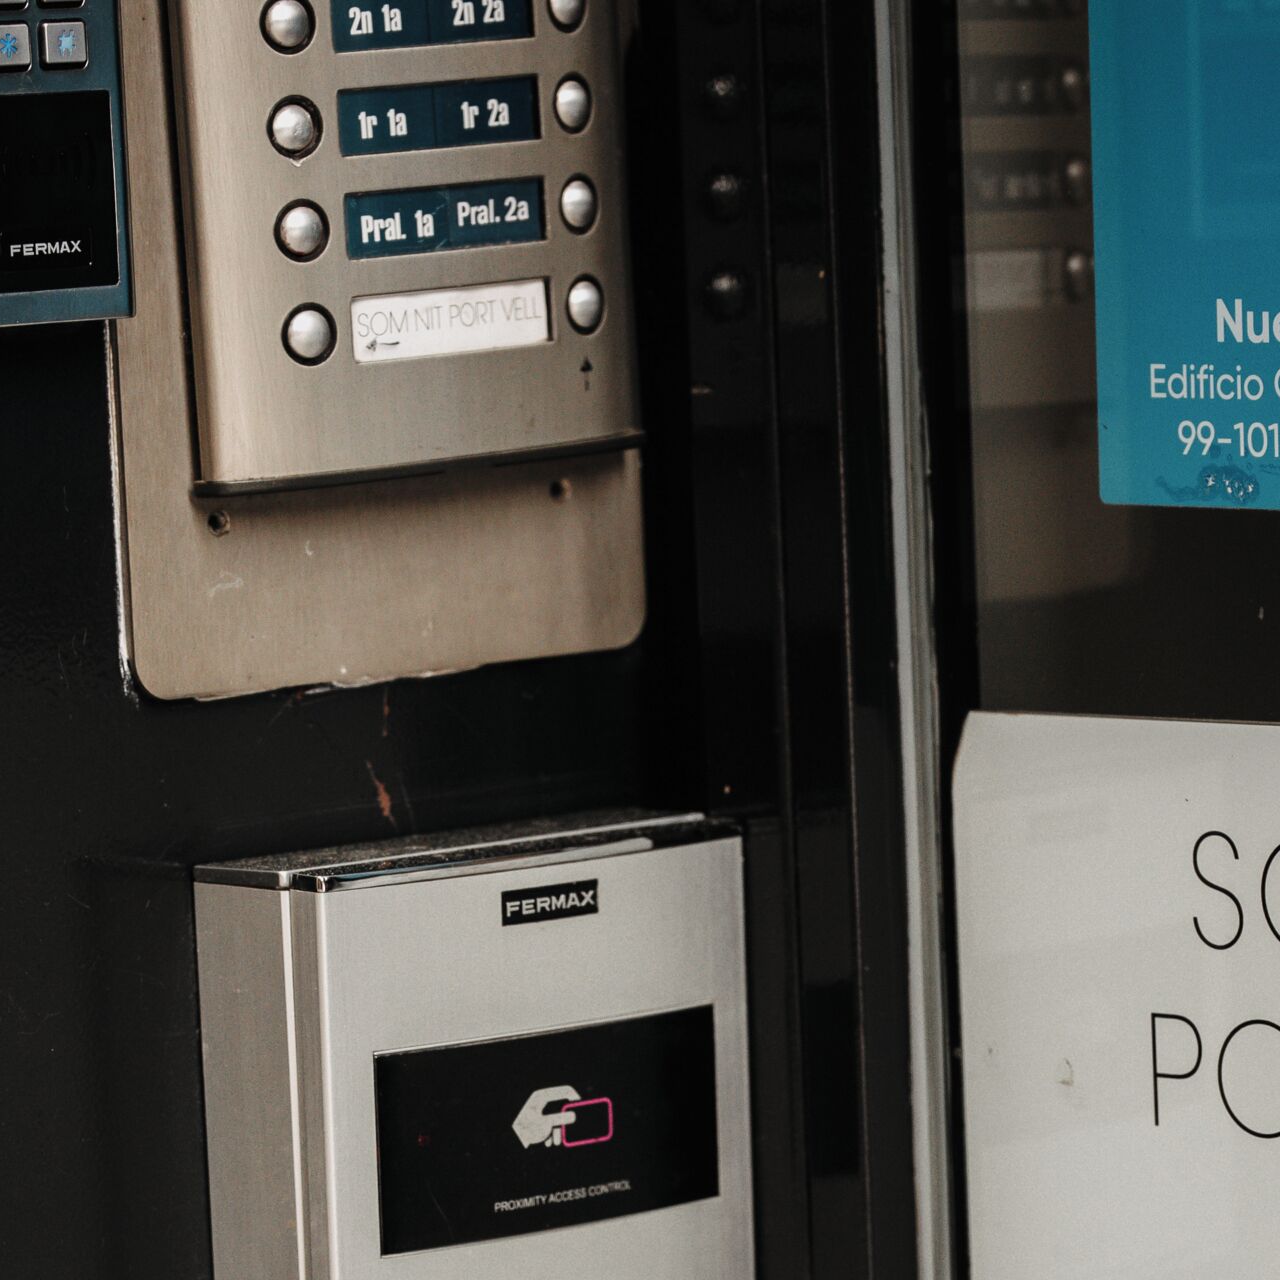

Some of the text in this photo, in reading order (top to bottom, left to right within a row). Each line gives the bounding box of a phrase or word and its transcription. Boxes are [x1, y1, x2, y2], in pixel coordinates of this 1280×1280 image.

[348, 4, 403, 36] 2n 1a
[451, 0, 505, 26] 2n 2a
[358, 108, 408, 140] 1r 1a
[460, 98, 510, 130] 1r 2a
[360, 209, 435, 244] Pral. 1a
[456, 196, 530, 227] Pral. 2a
[9, 239, 83, 257] FERMAX
[356, 296, 543, 338] SOM NIT PORT VELL
[1149, 362, 1265, 402] Edificio
[506, 890, 596, 918] FERMAX
[494, 1180, 632, 1213] PROXIMITY ACCESS CONTROL
